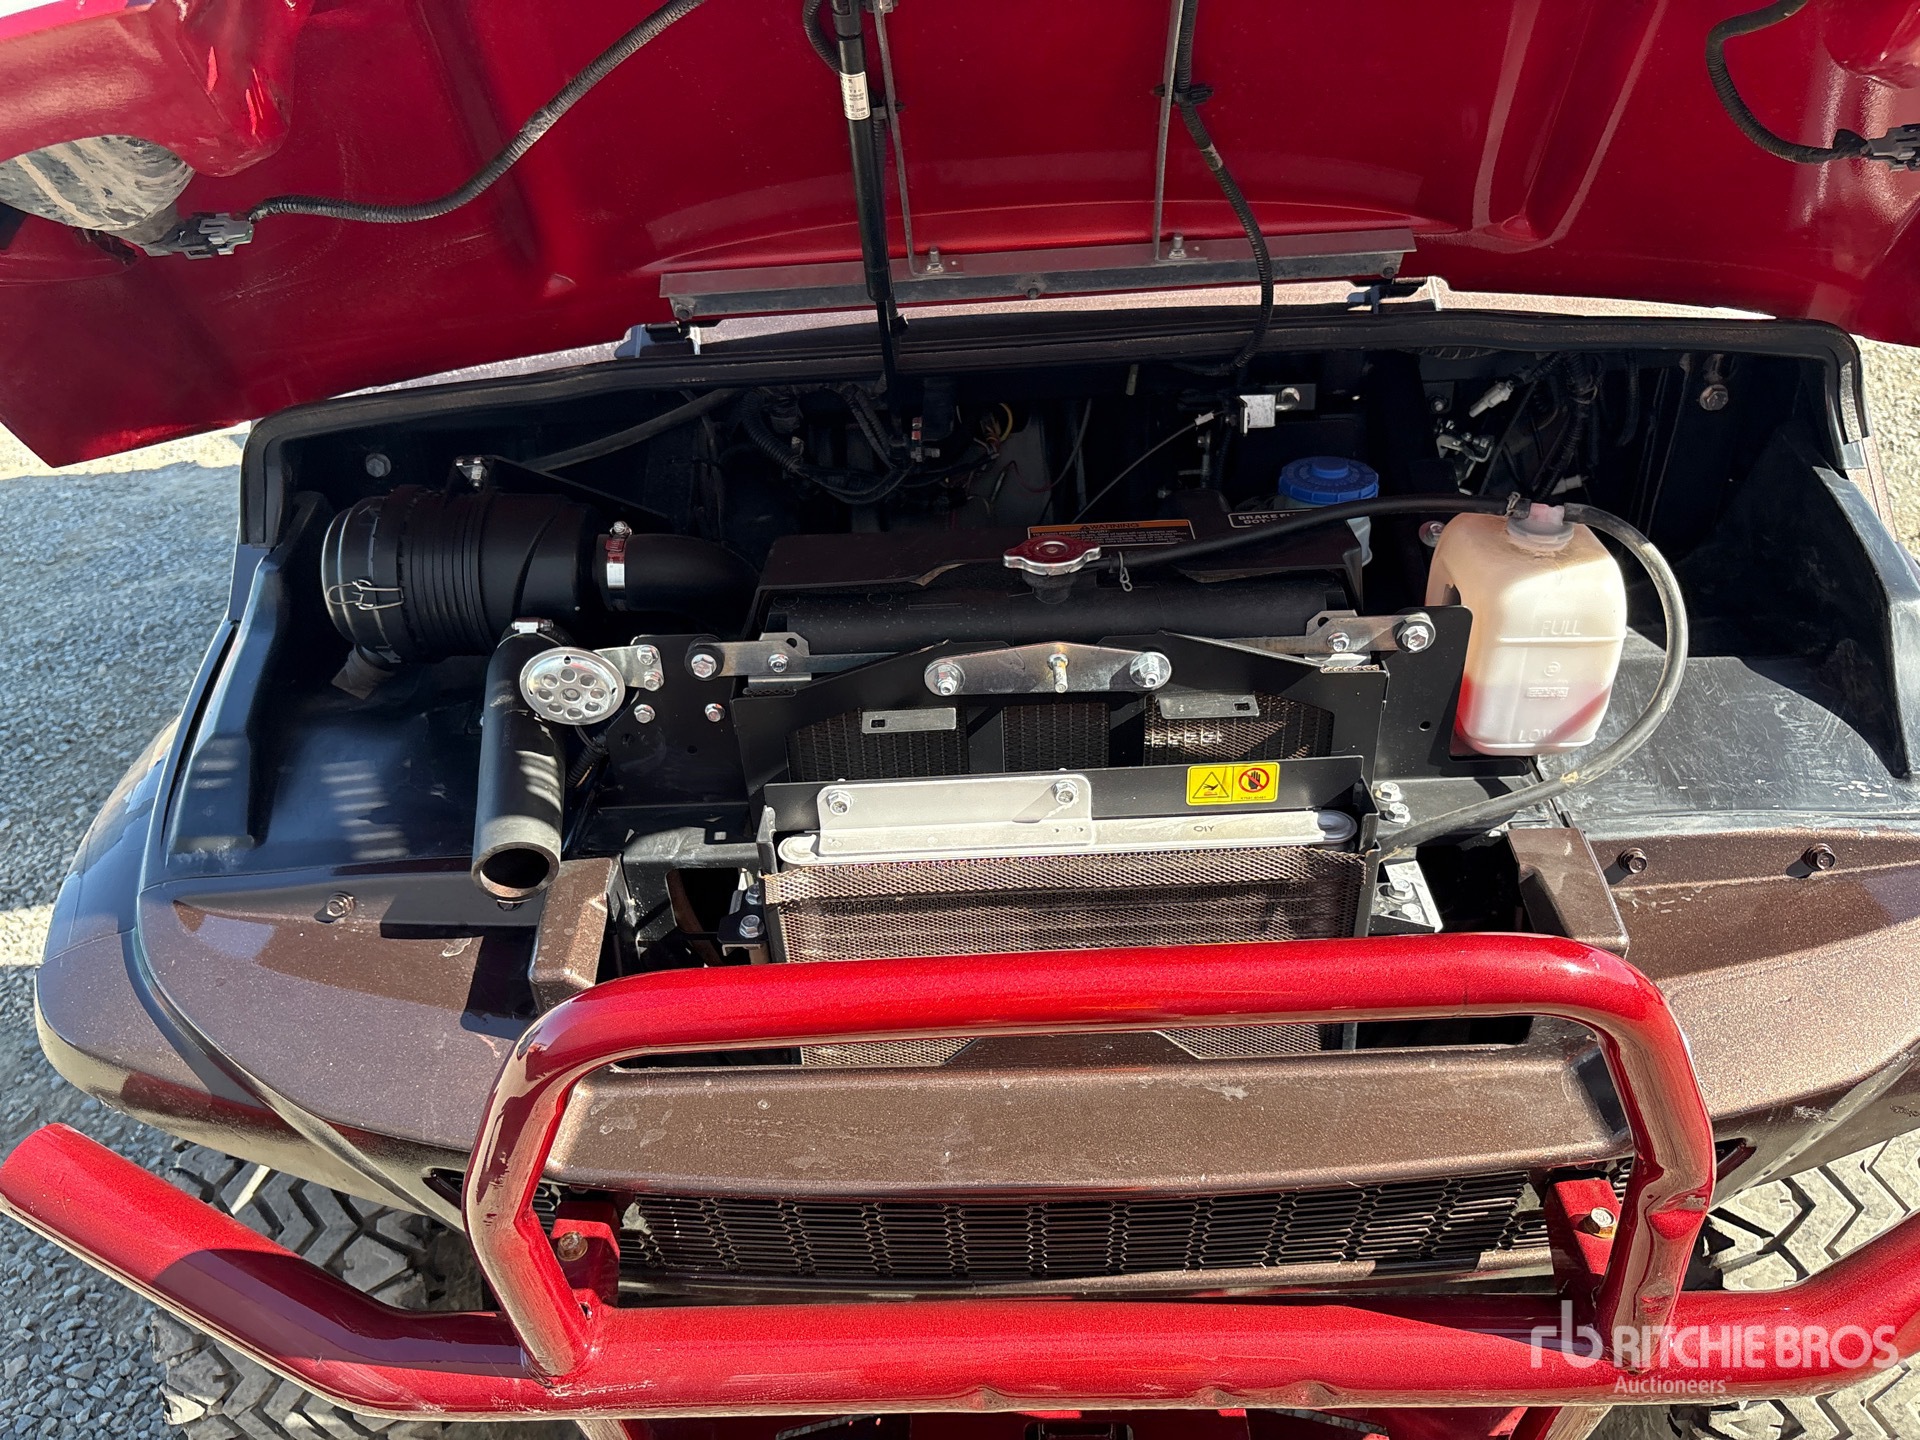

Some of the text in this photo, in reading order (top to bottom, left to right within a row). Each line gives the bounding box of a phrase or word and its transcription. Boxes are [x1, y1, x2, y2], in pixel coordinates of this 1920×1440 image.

[1237, 513, 1279, 521] BRAKE
[1089, 522, 1139, 530] WARNING
[1540, 619, 1581, 636] FULL
